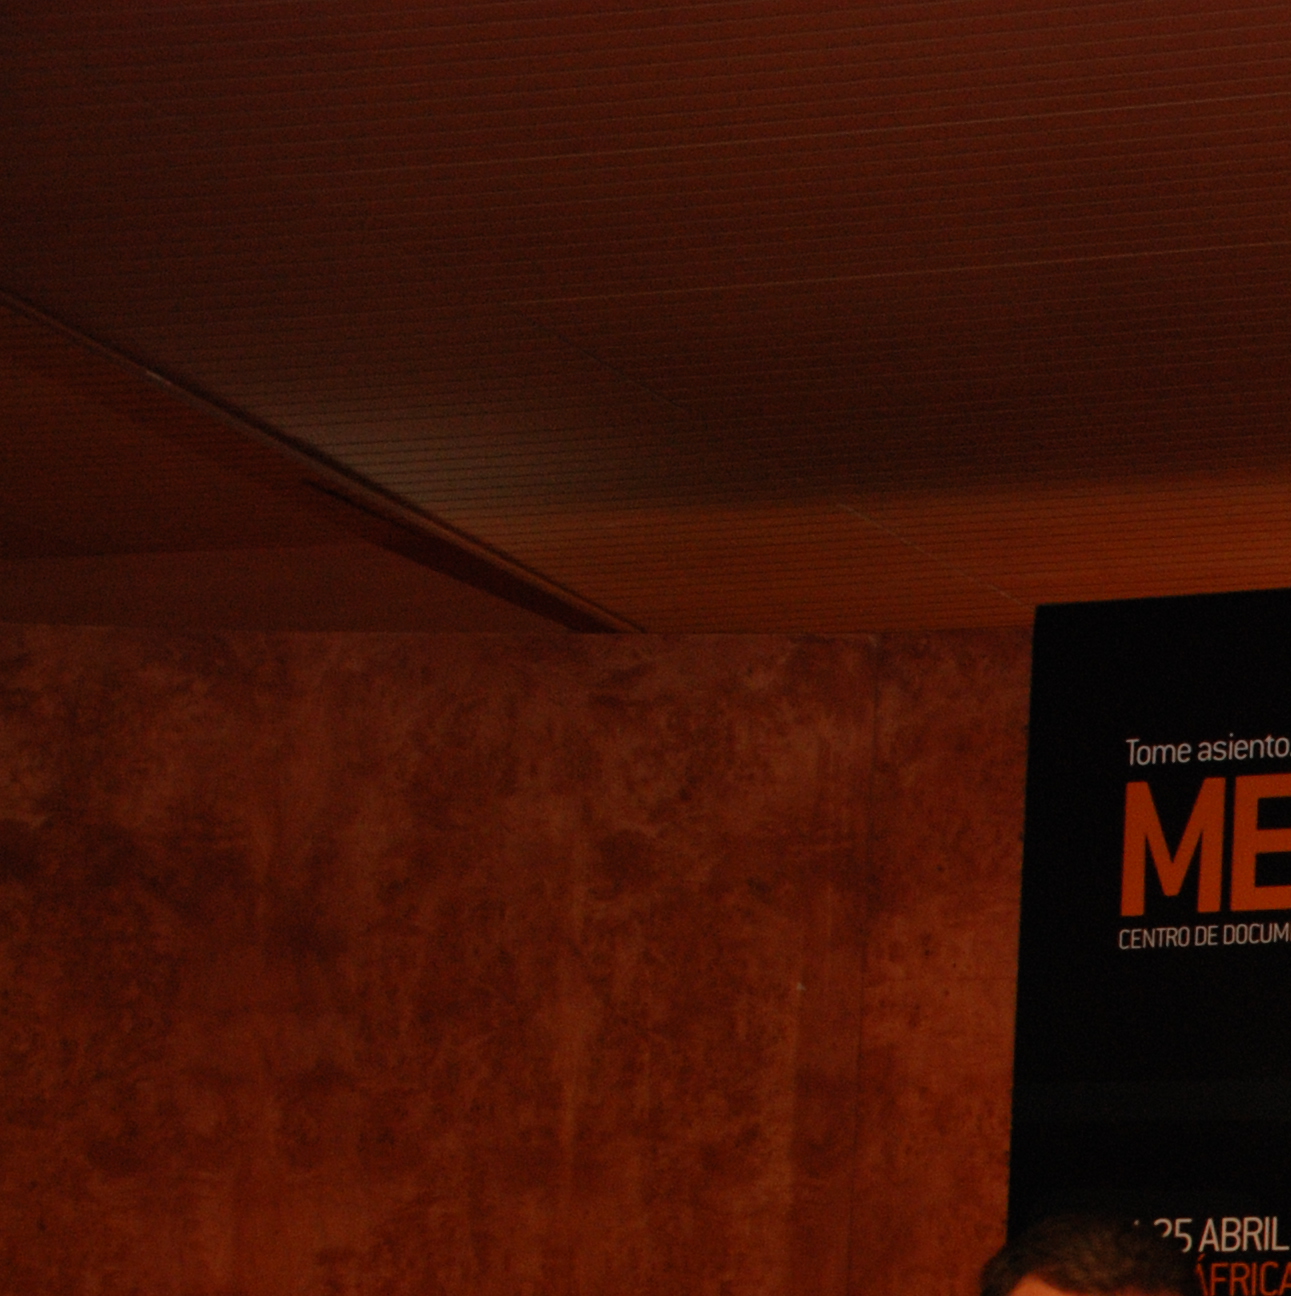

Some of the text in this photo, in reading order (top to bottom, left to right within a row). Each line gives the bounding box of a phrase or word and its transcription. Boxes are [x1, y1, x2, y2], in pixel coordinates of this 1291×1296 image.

[1126, 738, 1192, 766] Tome
[1118, 926, 1191, 950] CENTRO
[1194, 925, 1218, 946] DE
[1199, 1216, 1290, 1252] ABRIL
